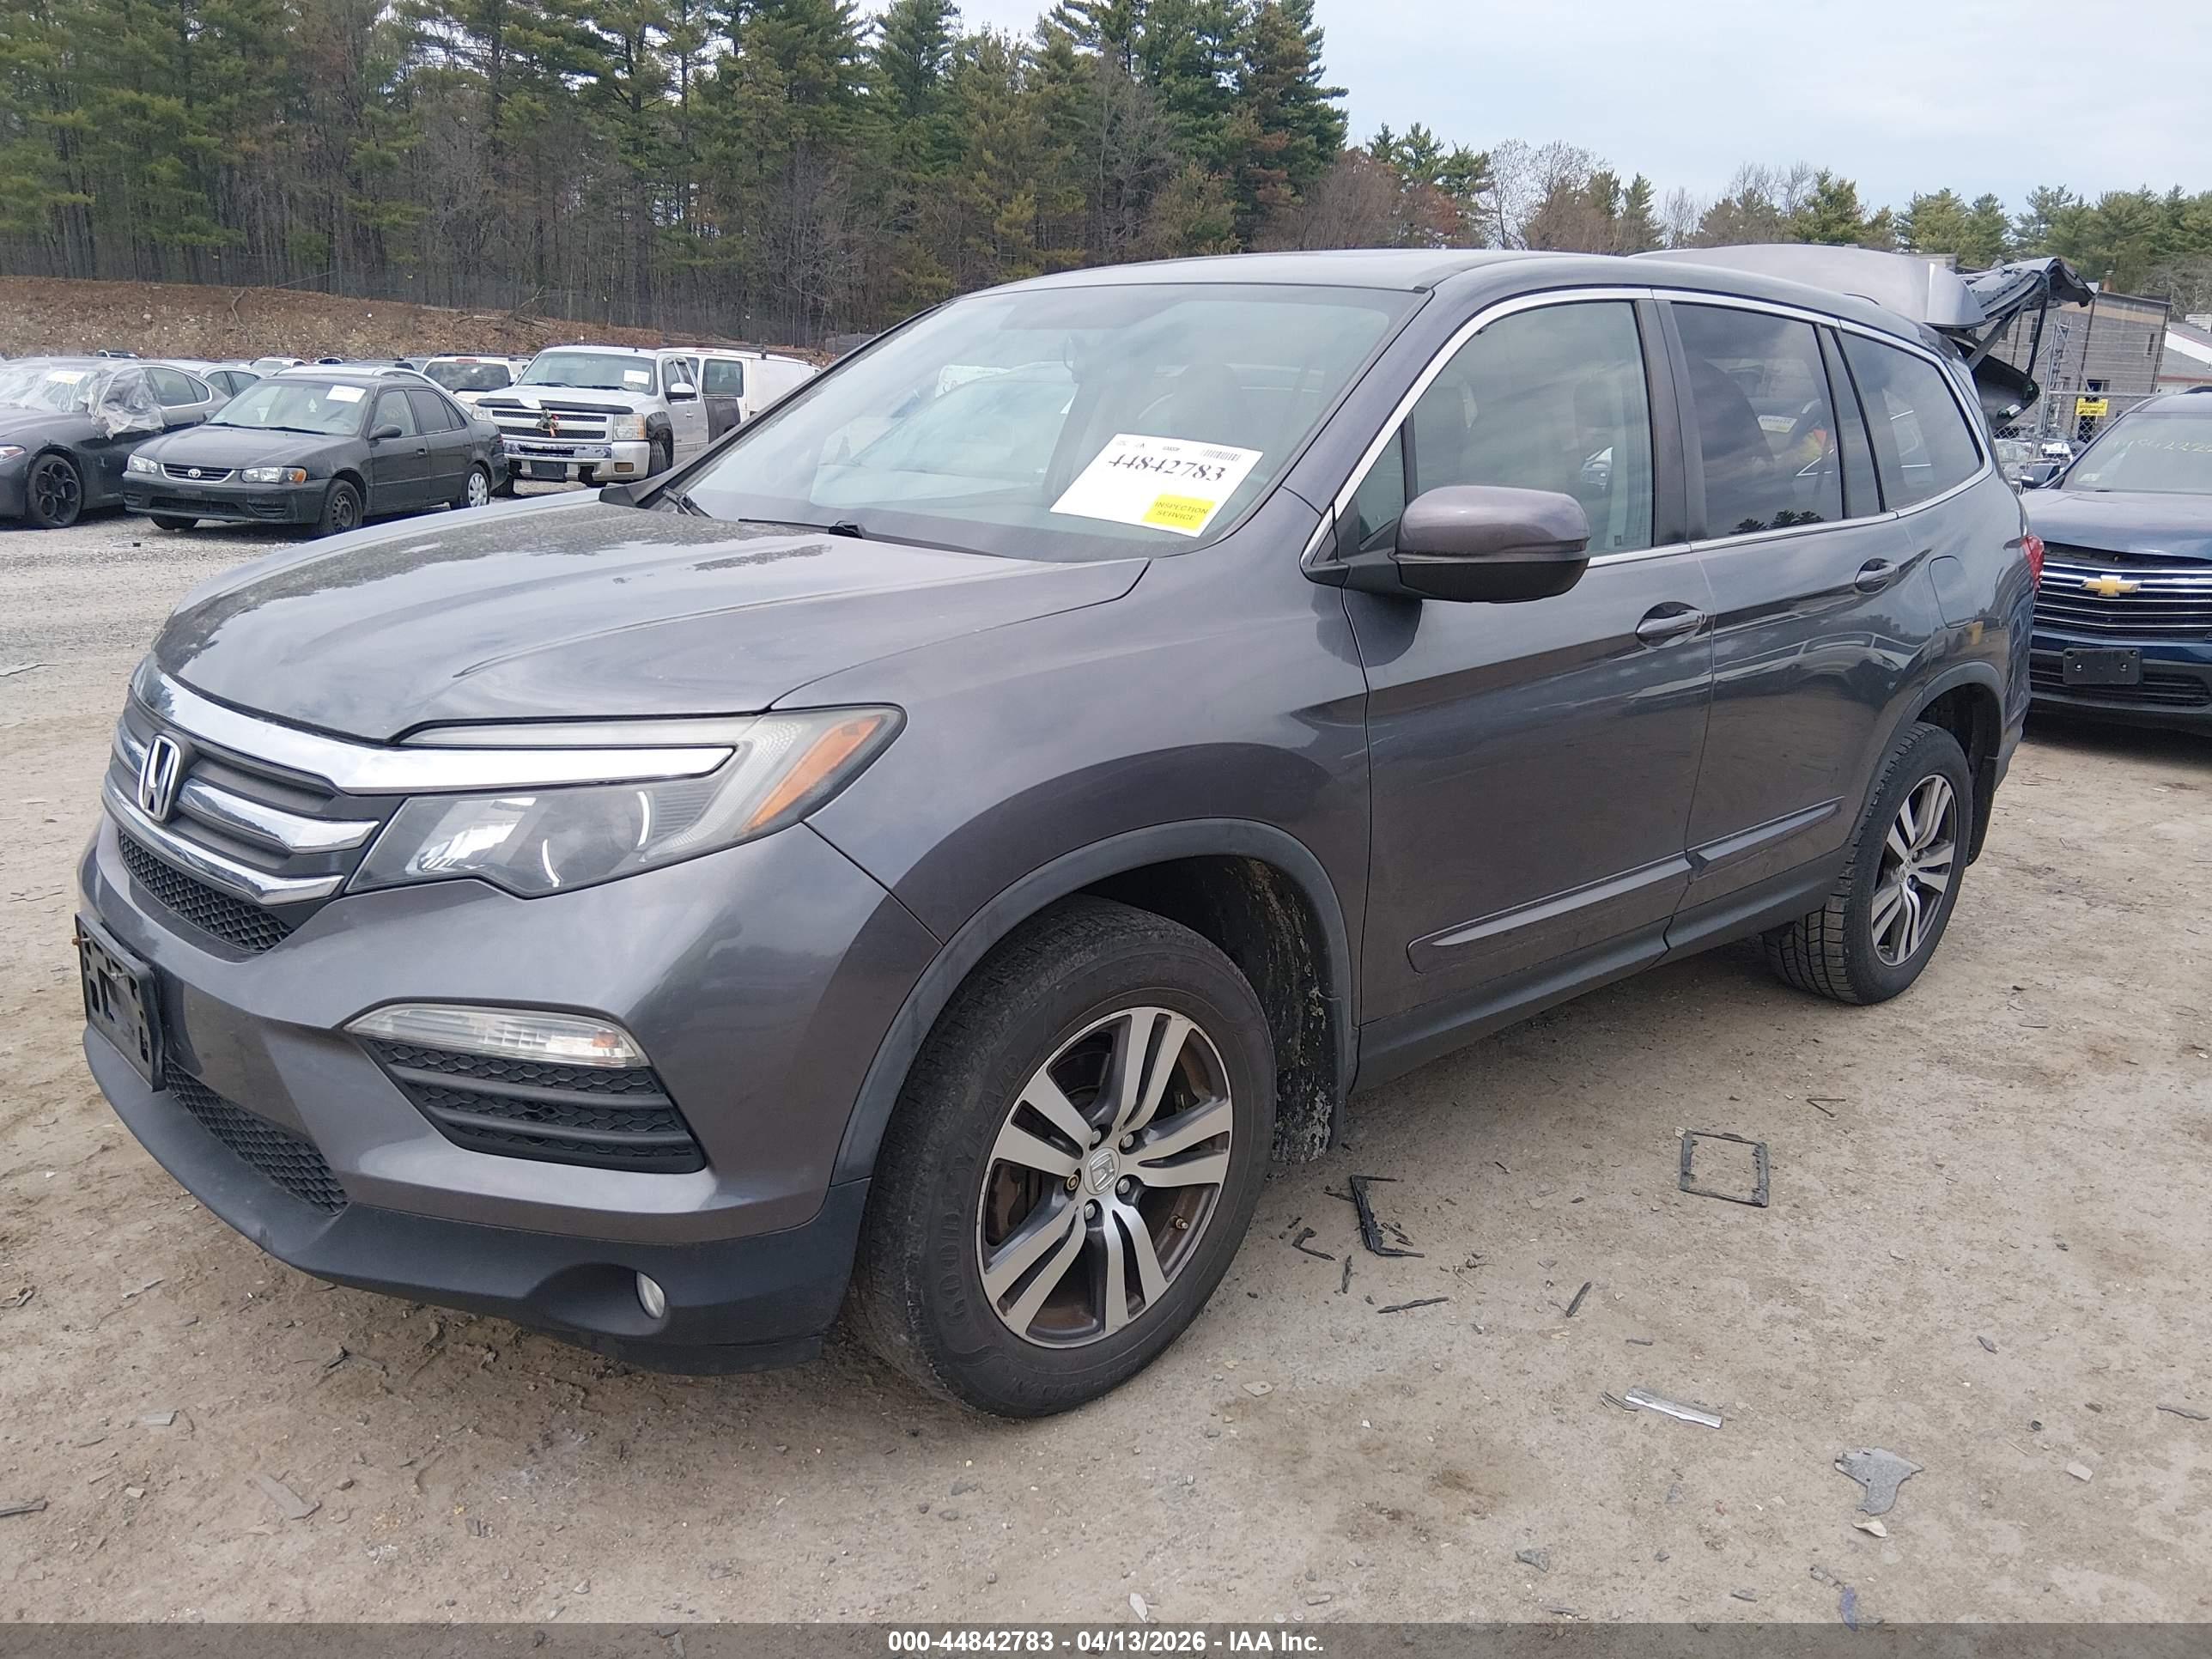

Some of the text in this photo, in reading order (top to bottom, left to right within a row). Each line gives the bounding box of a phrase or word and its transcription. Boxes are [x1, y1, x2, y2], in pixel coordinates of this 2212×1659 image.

[1109, 454, 1225, 481] 44842783
[1154, 501, 1209, 514] INSPECTION
[1156, 510, 1196, 522] SERVICE
